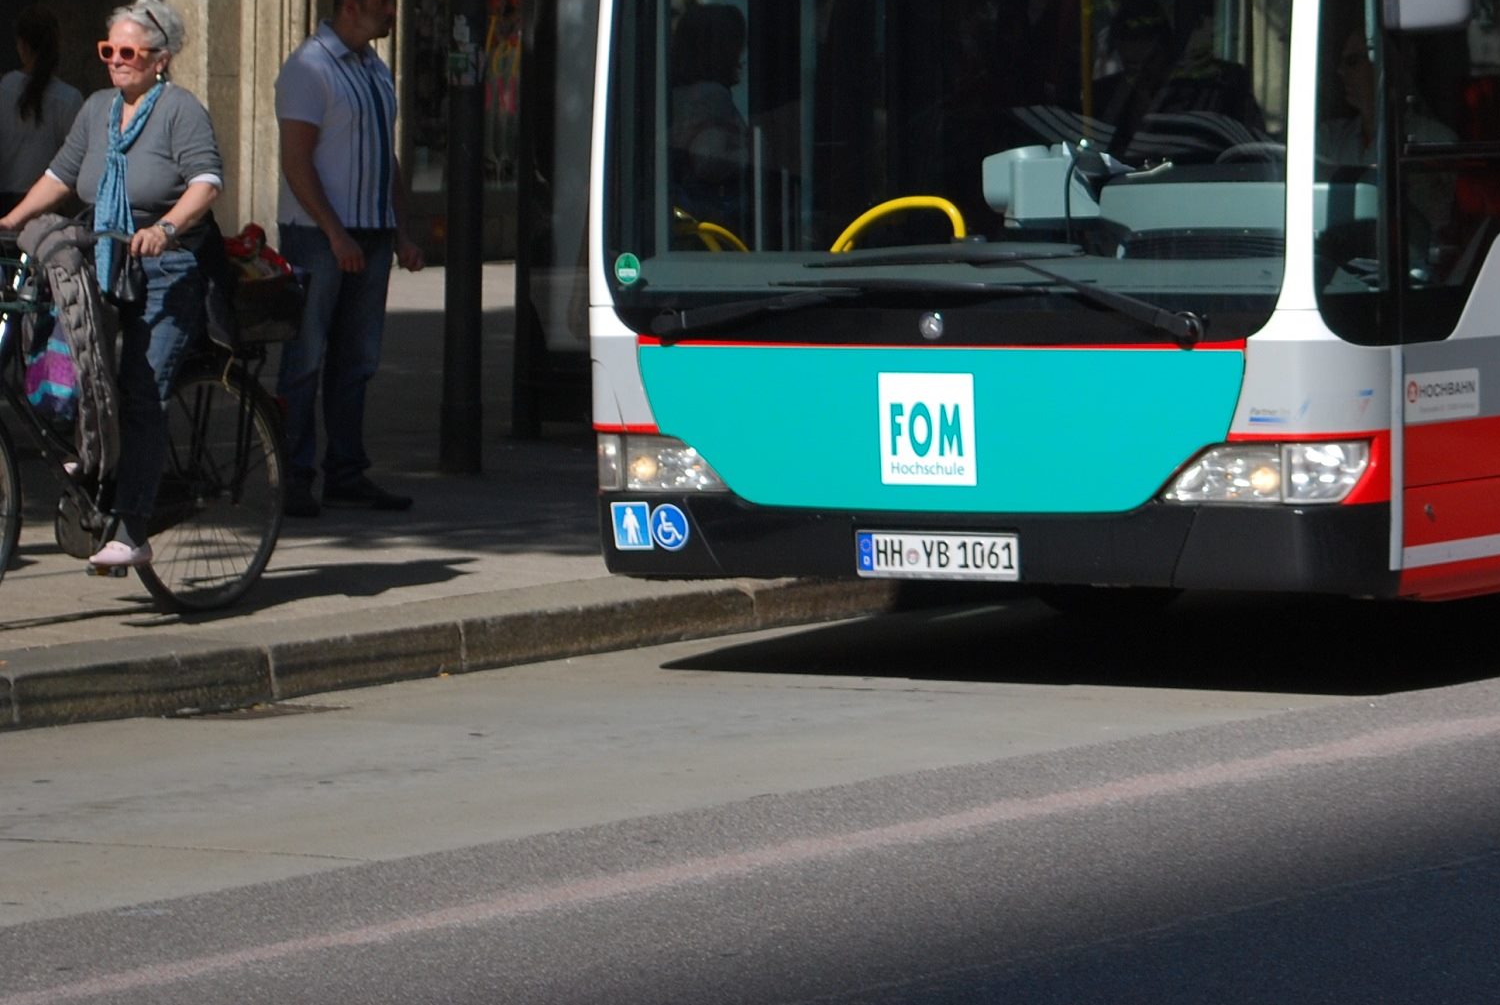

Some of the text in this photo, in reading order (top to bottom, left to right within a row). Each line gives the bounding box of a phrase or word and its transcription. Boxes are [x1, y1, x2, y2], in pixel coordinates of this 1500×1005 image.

[1419, 380, 1475, 398] HOCHBAHN
[890, 401, 964, 457] FOM
[890, 461, 965, 476] Hochschule
[876, 539, 1015, 570] HH YB 1061
